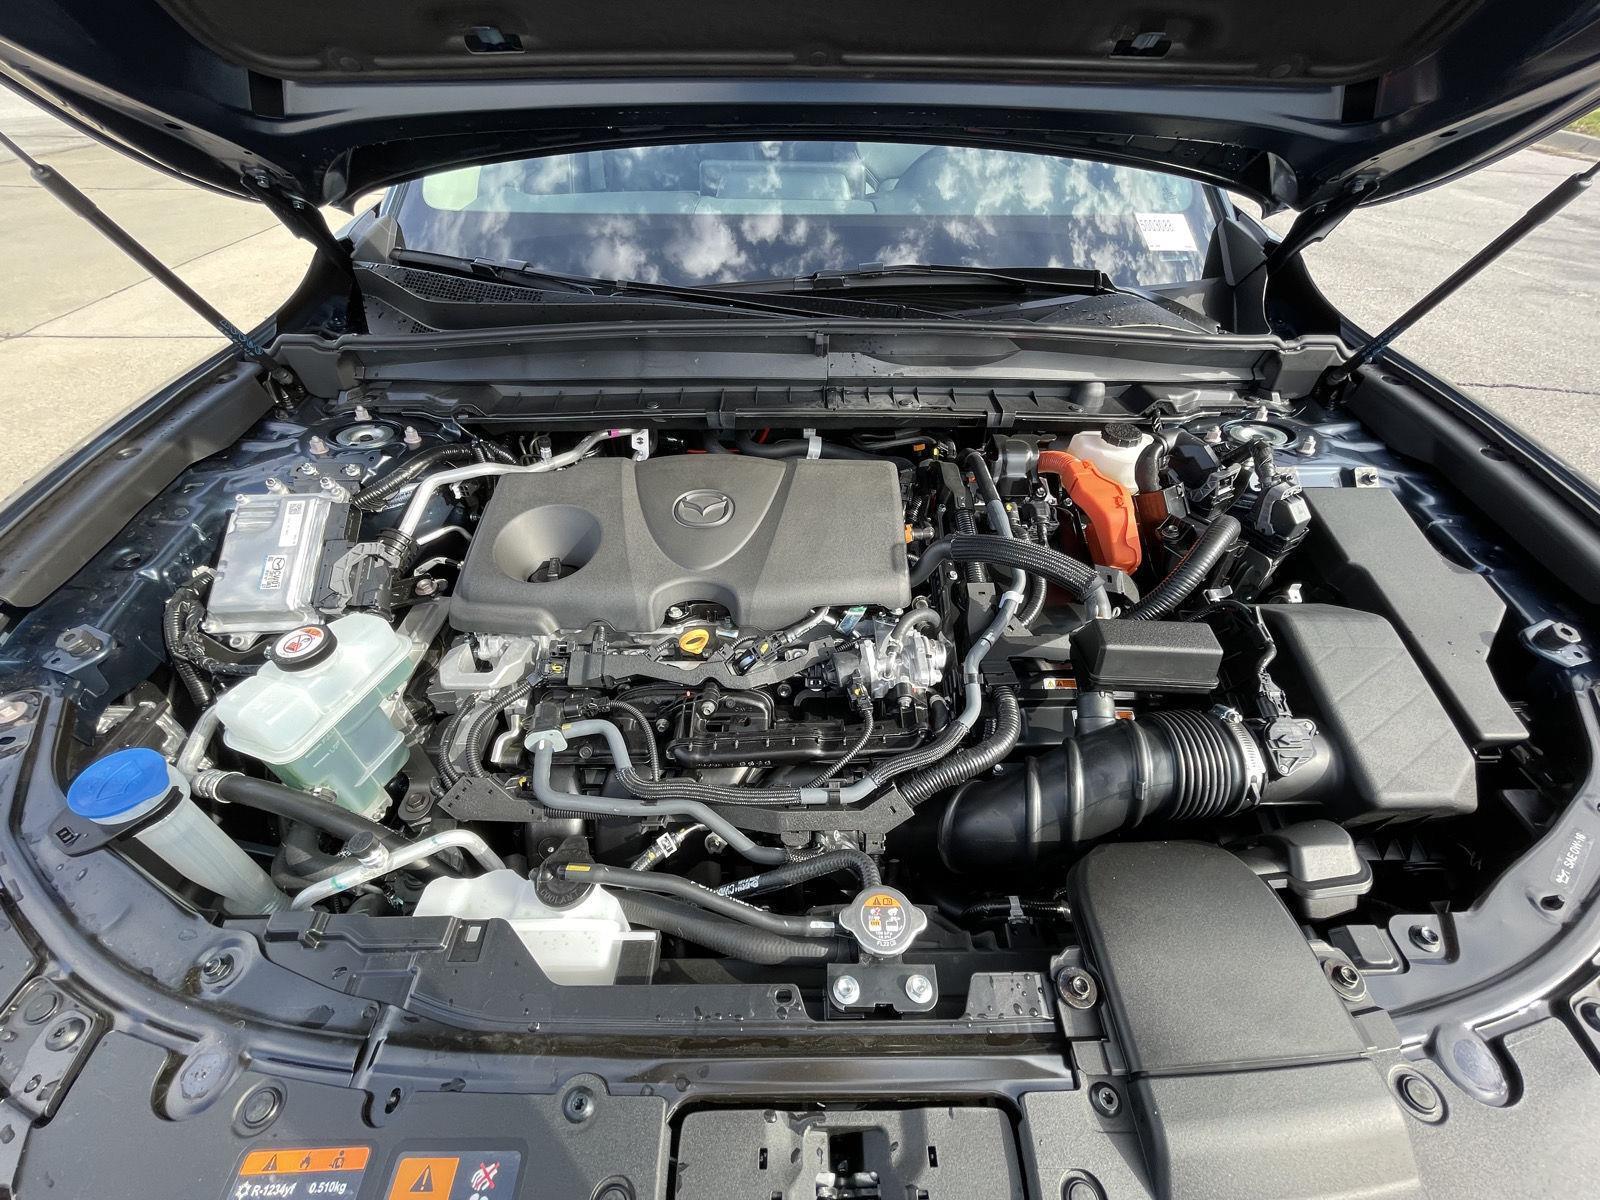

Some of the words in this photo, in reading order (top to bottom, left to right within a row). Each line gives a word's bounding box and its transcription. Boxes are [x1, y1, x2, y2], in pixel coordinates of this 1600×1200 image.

[1570, 832, 1587, 855] 0W-16
[1563, 851, 1578, 869] SAE
[540, 888, 579, 904] COOLANT
[250, 1180, 298, 1197] R-1234yf
[308, 1180, 347, 1195] 0.510kg
